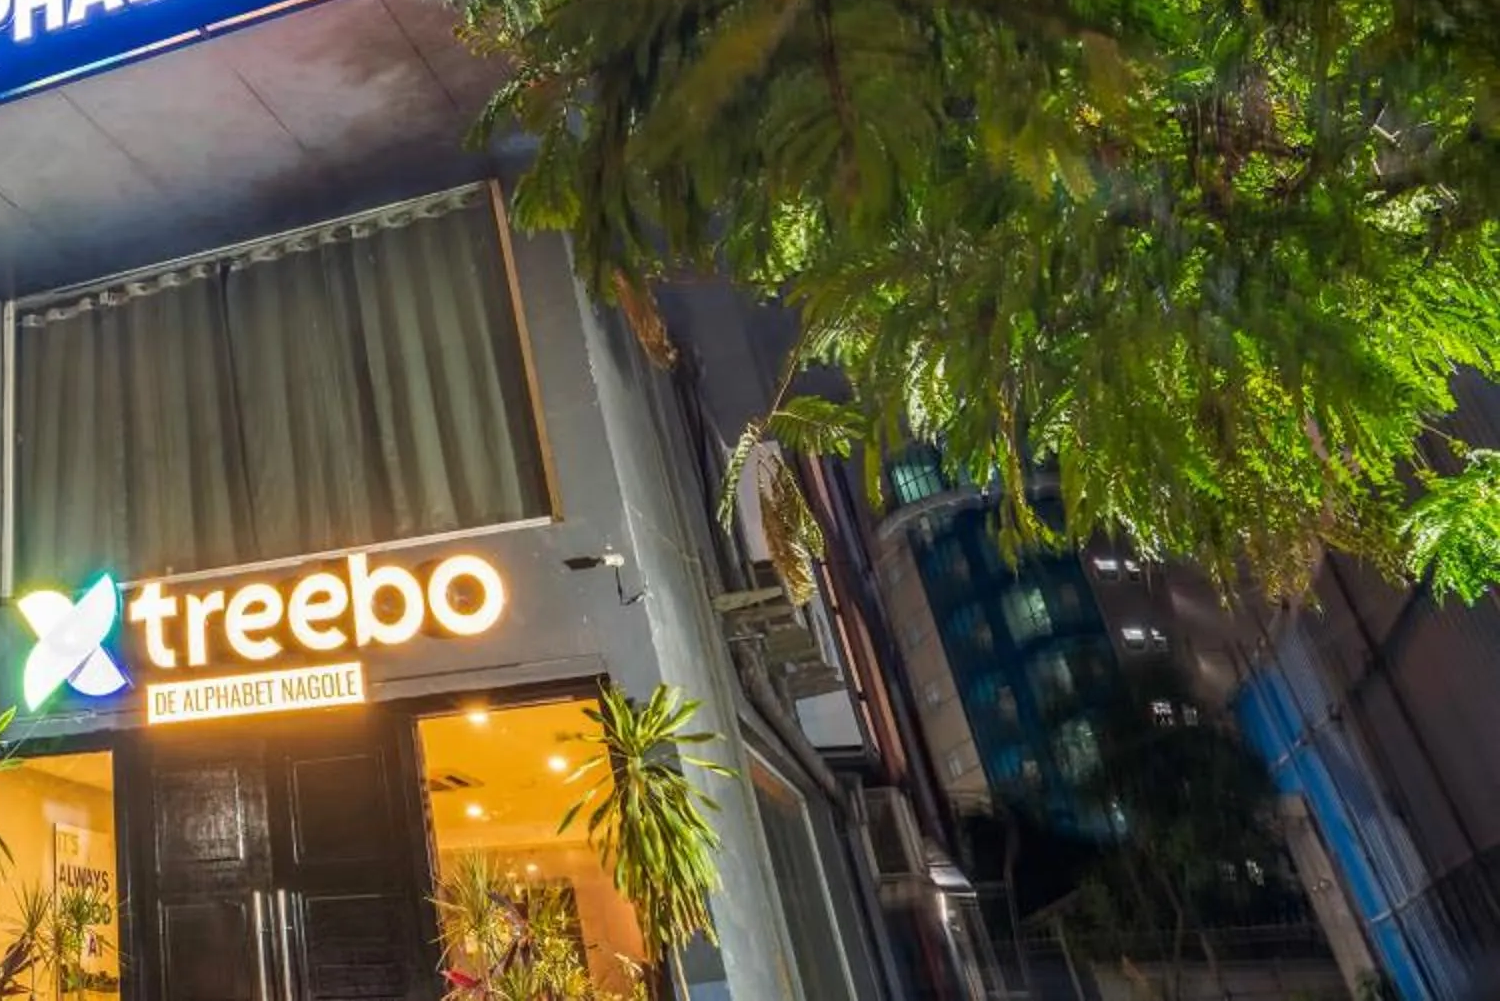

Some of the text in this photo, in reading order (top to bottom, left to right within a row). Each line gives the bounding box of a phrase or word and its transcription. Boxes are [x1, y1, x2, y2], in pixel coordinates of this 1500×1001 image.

[131, 552, 504, 668] treebo
[155, 670, 357, 716] DE ALPHABET NAGOLE
[59, 862, 109, 894] ALWAYS
